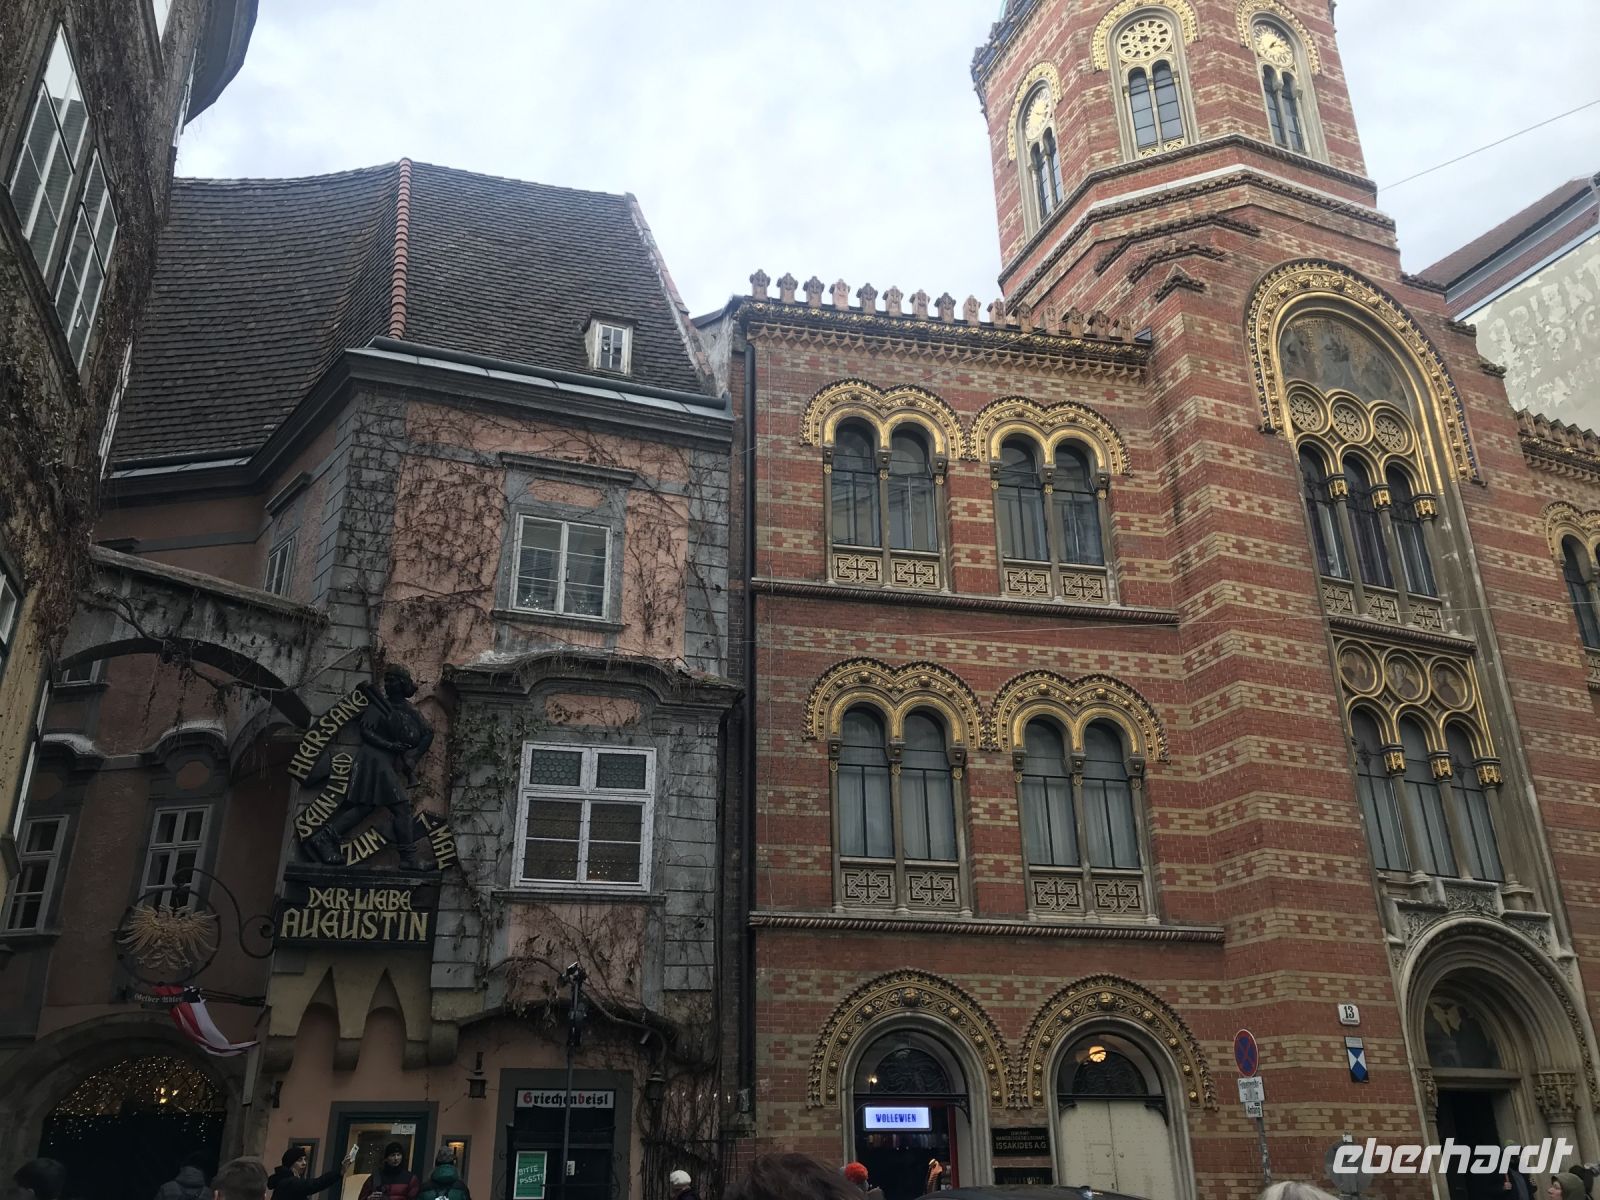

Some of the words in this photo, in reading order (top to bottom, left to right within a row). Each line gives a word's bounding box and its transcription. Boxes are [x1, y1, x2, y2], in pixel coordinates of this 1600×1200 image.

[341, 827, 387, 866] ZUM
[280, 907, 429, 942] AUGUSTIN
[1344, 1005, 1355, 1018] 13
[875, 1113, 917, 1123] WOLLEWIEN
[996, 1141, 1033, 1150] ISSAKIDES
[518, 1164, 539, 1176] BITTE
